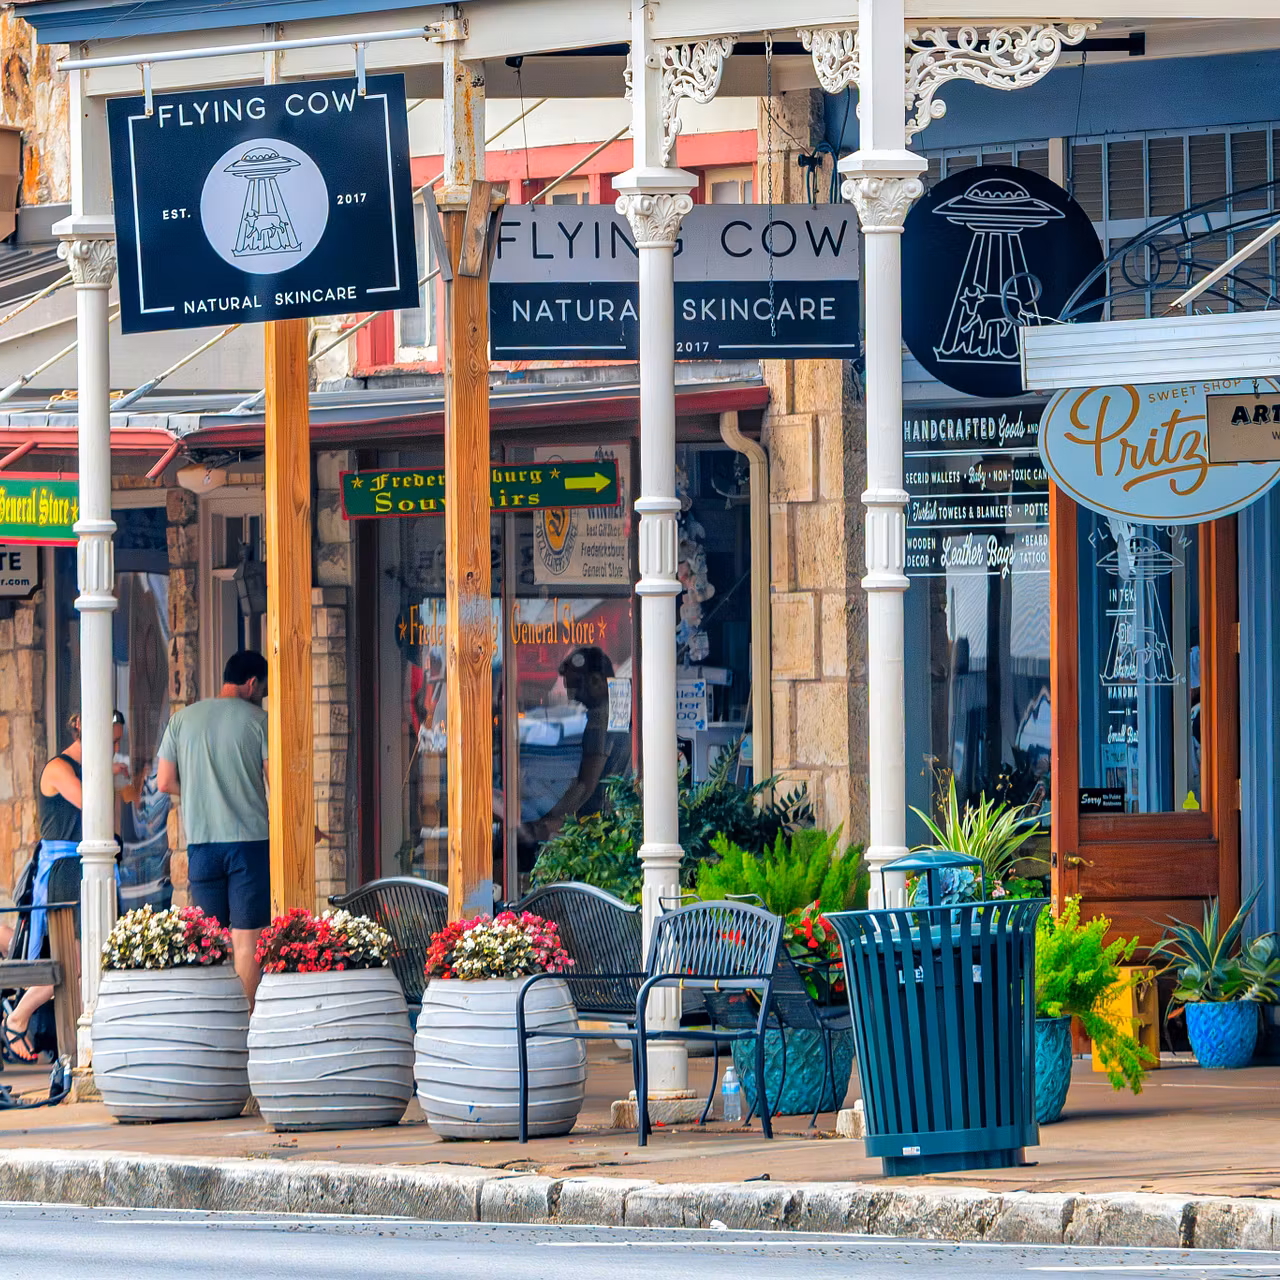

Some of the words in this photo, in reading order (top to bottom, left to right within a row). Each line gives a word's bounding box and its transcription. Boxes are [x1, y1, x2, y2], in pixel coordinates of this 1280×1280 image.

[158, 97, 266, 128] FLYING
[285, 88, 356, 117] COW
[336, 193, 368, 206] 2017
[162, 209, 192, 220] EST.
[496, 220, 683, 259] FLYIN
[721, 220, 847, 259] COW
[184, 295, 262, 314] NATURAL
[274, 286, 357, 306] SKINCARE
[512, 298, 639, 322] NATURA
[682, 296, 836, 321] SKINCARE
[676, 341, 710, 353] 2017
[1149, 386, 1196, 403] SWEET
[1204, 379, 1242, 393] SHOP
[904, 418, 996, 443] HANDCRAFTED
[999, 411, 1025, 446] Goods
[1027, 423, 1038, 434] AND
[906, 473, 929, 484] SECRID
[931, 471, 960, 483] WALLETS
[993, 469, 1031, 481] NON-TOXIC
[39, 488, 69, 525] Store
[913, 500, 937, 521] Turkish
[938, 506, 966, 519] TOWELS
[977, 505, 1012, 518] BLANKETS
[1024, 503, 1048, 516] POTTE
[907, 538, 936, 550] WOODEN
[1025, 534, 1047, 546] BEARD
[581, 542, 625, 561] Fredericksburg
[907, 555, 930, 567] DECOR
[940, 533, 983, 567] Leather
[987, 535, 1015, 579] Bags
[1020, 552, 1046, 564] TATTOO
[1109, 589, 1117, 602] IN
[510, 597, 558, 645] General
[561, 603, 595, 645] Store
